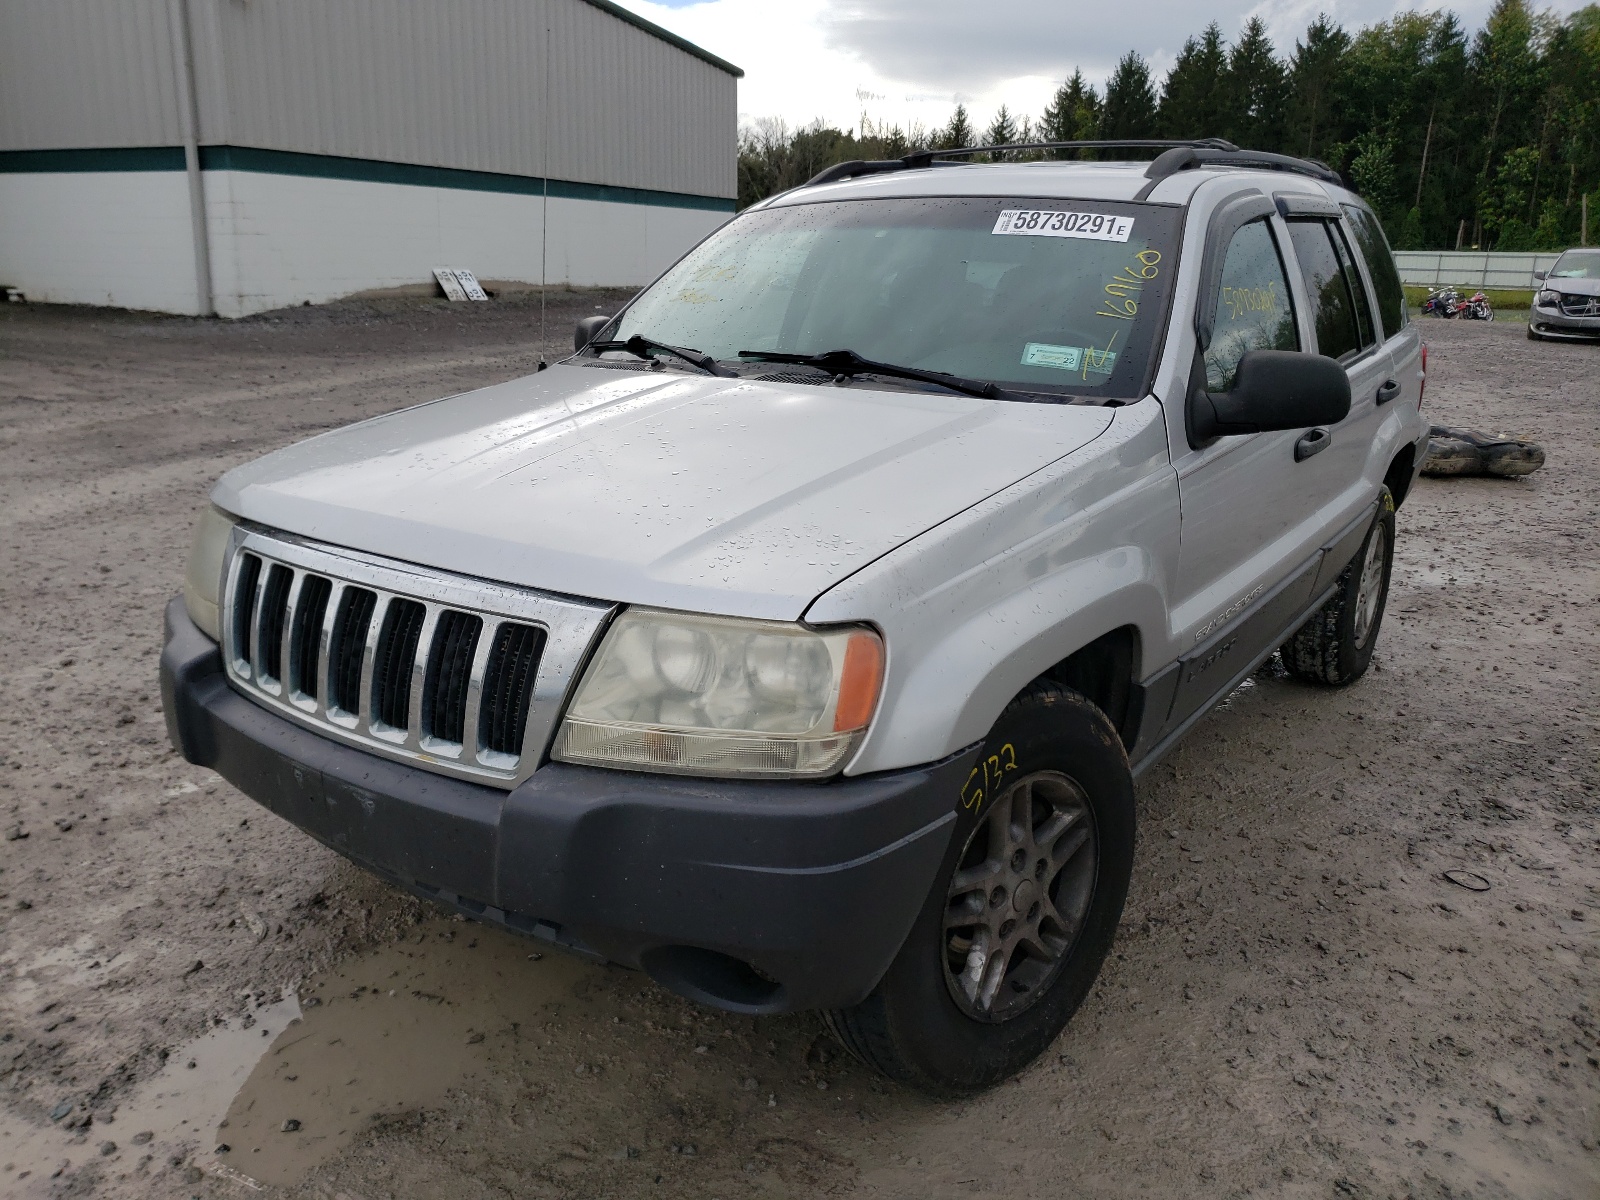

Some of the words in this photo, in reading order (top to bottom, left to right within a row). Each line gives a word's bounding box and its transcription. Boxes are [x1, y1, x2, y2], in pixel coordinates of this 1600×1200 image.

[1013, 211, 1117, 235] 58730291
[1116, 225, 1127, 236] E
[1062, 357, 1076, 365] 22
